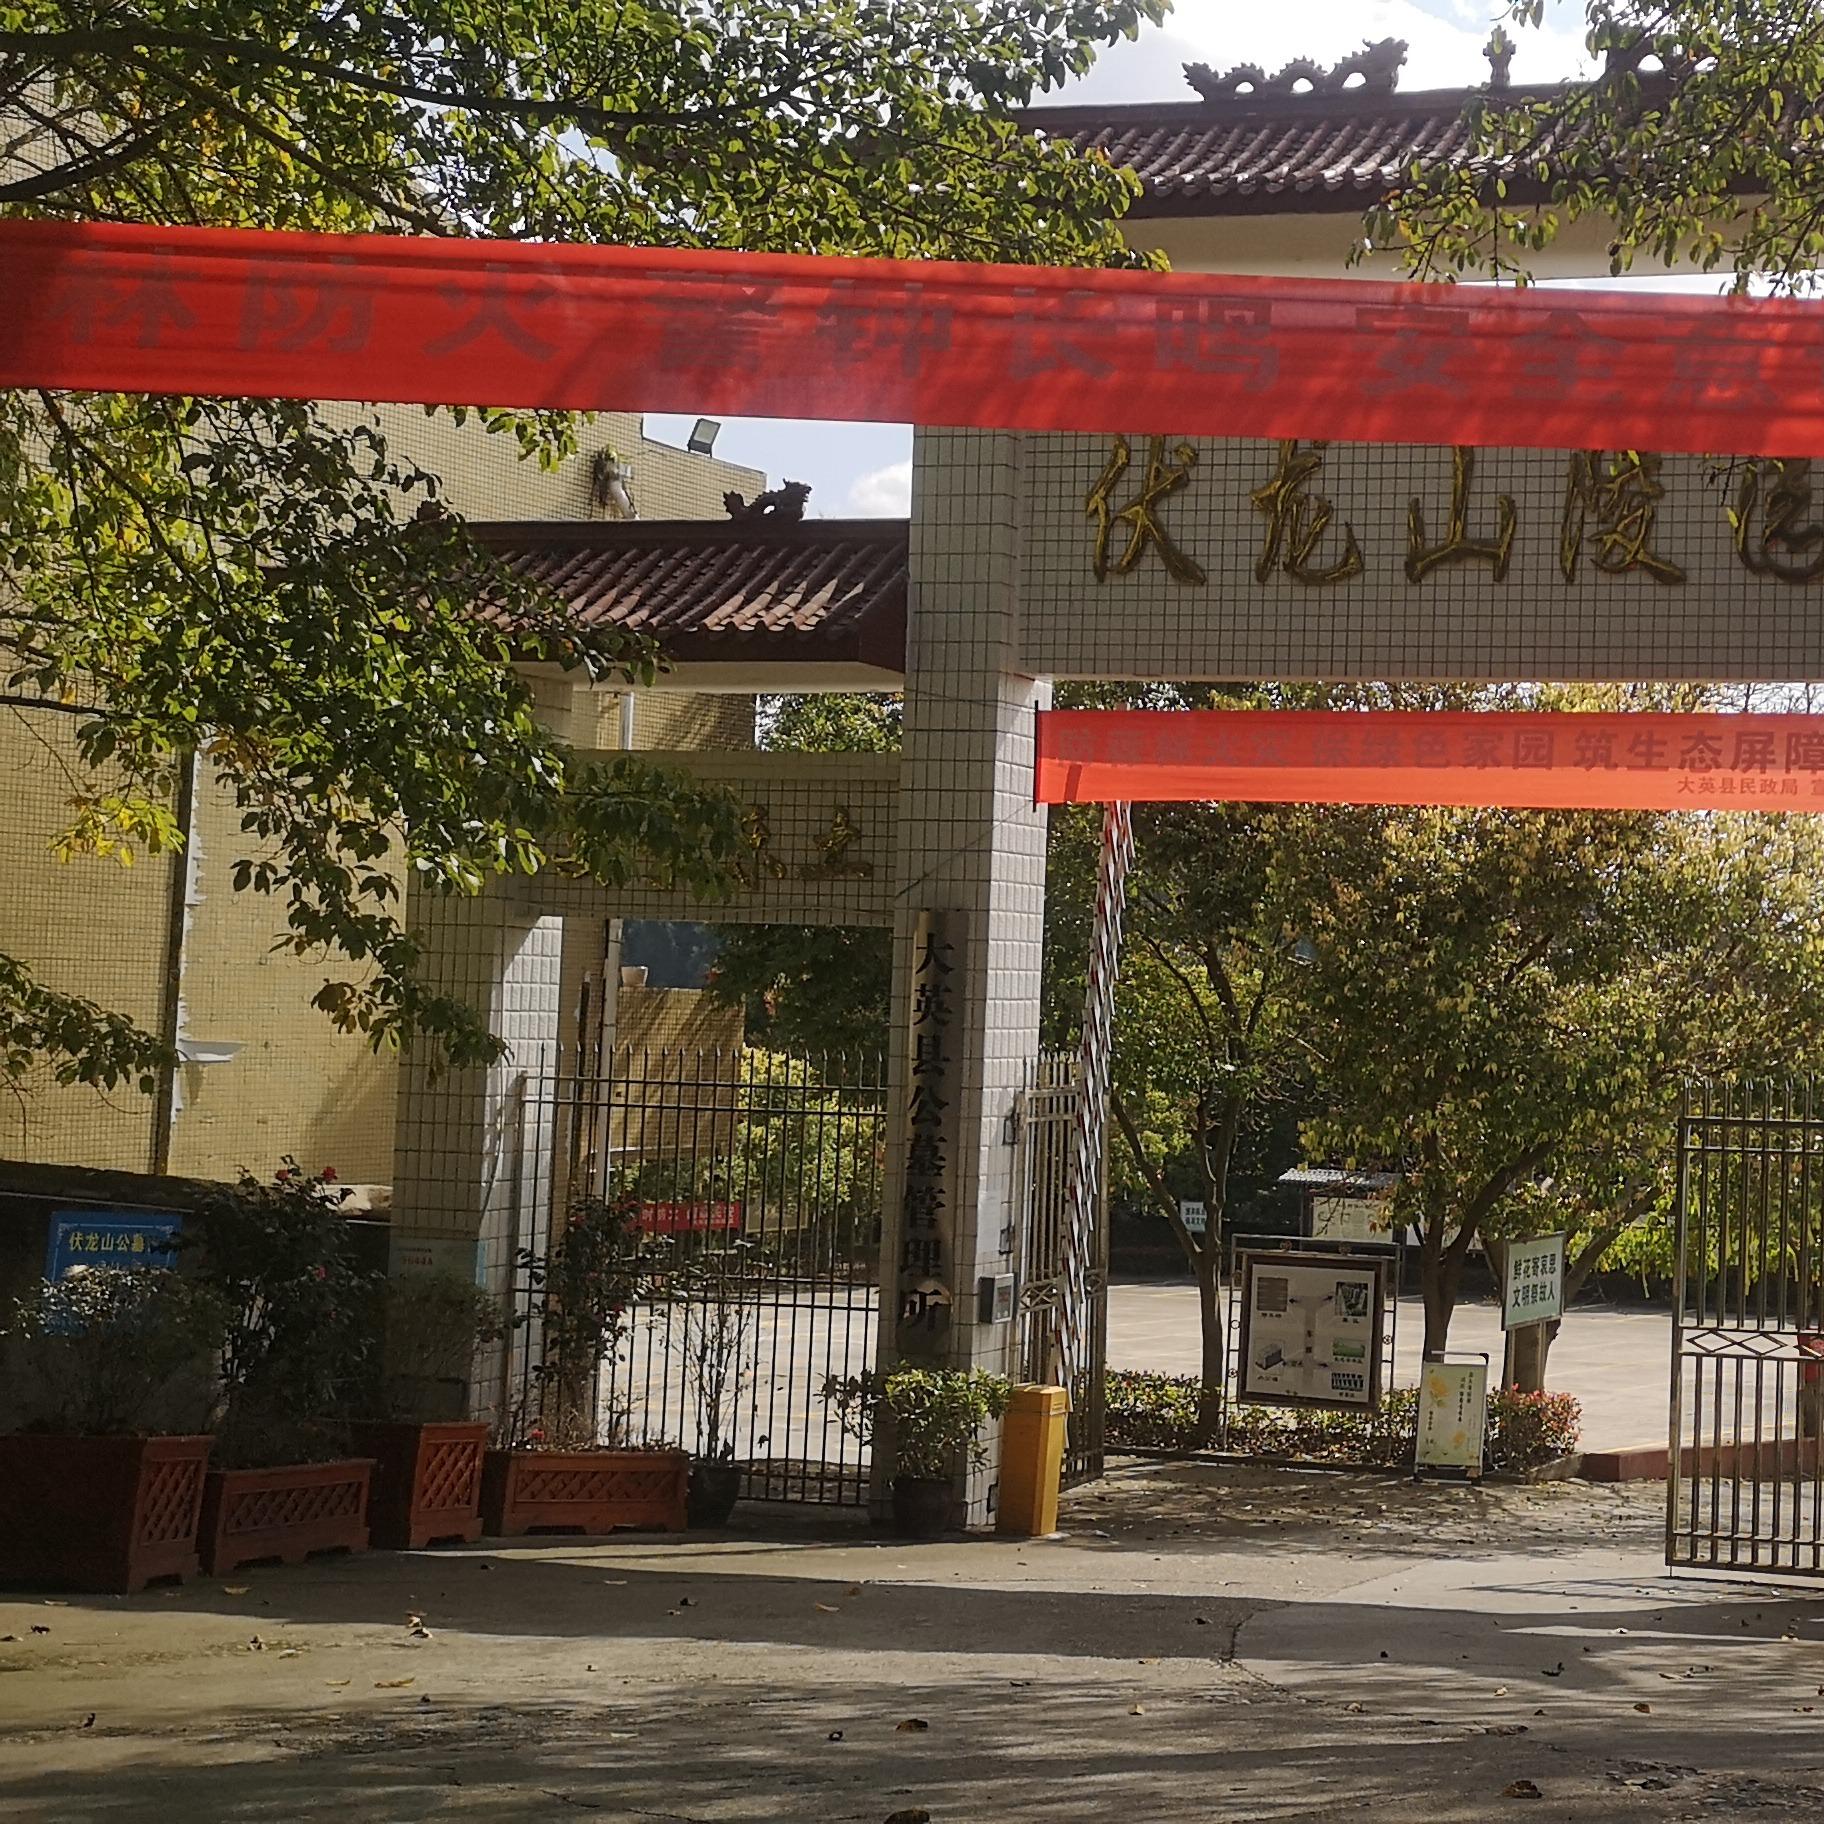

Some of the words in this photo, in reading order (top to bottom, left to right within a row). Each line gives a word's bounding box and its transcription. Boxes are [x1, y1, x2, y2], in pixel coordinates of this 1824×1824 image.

[44, 246, 560, 362] 林防火
[644, 271, 1282, 393] 警钟长鸣
[1677, 776, 1799, 796] 大英县民政局
[898, 932, 956, 1332] 大英县公墓管理所
